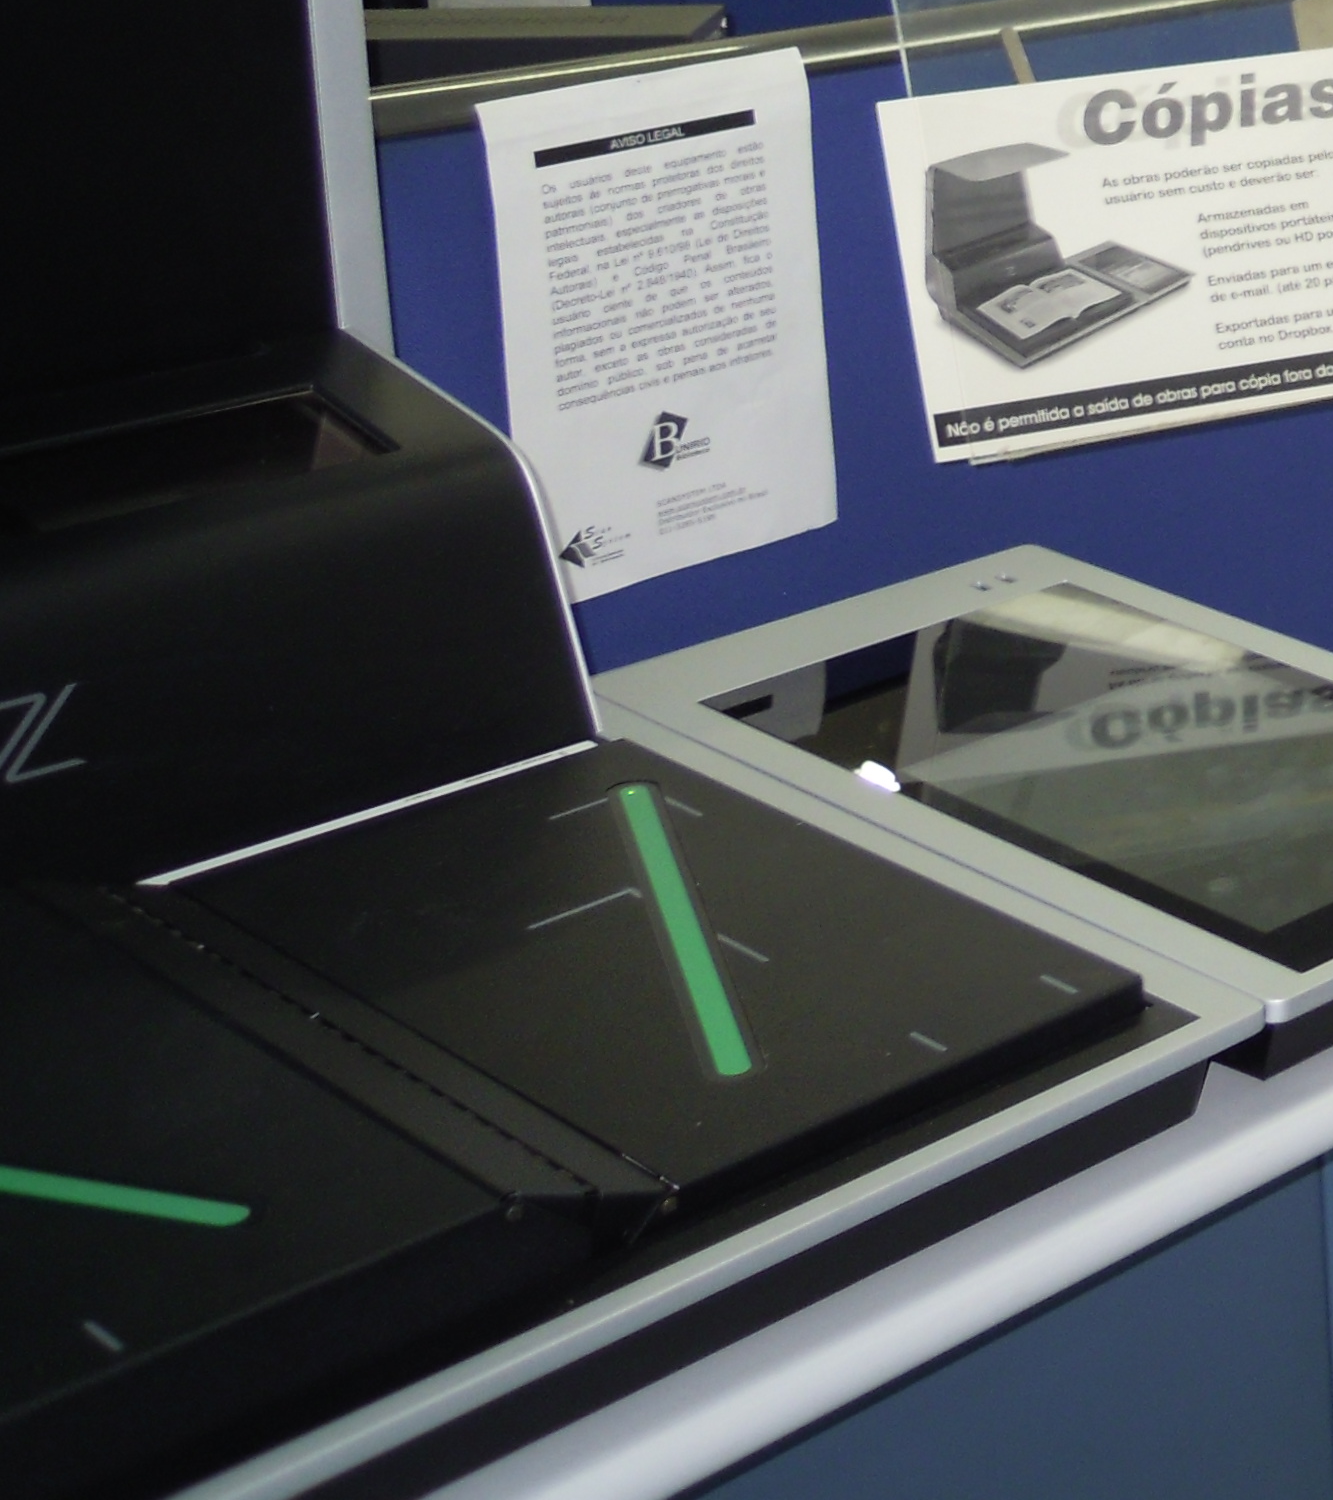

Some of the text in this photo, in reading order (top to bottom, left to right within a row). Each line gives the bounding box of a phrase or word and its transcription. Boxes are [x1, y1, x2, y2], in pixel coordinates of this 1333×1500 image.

[610, 127, 685, 149] AVISO LEGAL
[1102, 177, 1119, 188] As
[1123, 172, 1160, 186] obras
[1164, 163, 1218, 182] poderão
[1223, 163, 1242, 173] ser
[1246, 155, 1304, 170] copiadas
[1105, 188, 1154, 205] usuário
[1159, 186, 1185, 197] sem
[1189, 181, 1225, 194] custo
[1229, 180, 1236, 188] e
[1240, 172, 1292, 187] deverão
[1197, 200, 1309, 223] Armazenadas em
[1200, 221, 1277, 240] dispositivos
[1203, 238, 1271, 258] (pendrives
[1275, 235, 1291, 245] ou
[1295, 230, 1313, 242] HD
[1207, 270, 1266, 286] Enviadas
[1270, 264, 1300, 279] para
[1304, 261, 1322, 272] um
[1210, 291, 1226, 302] de
[1305, 275, 1321, 289] 20
[1215, 315, 1290, 334] Exportadas
[1293, 308, 1323, 323] para
[1218, 335, 1255, 349] conta
[1260, 331, 1274, 343] no
[946, 418, 981, 438] Não
[984, 415, 996, 430] é
[998, 401, 1071, 432] permitida
[1073, 405, 1085, 418] a
[1087, 394, 1129, 416] saída
[1131, 391, 1153, 408] de
[1156, 386, 1198, 406] obras
[1200, 378, 1237, 400] para
[1240, 370, 1281, 396] cópia
[1283, 366, 1312, 385] fora
